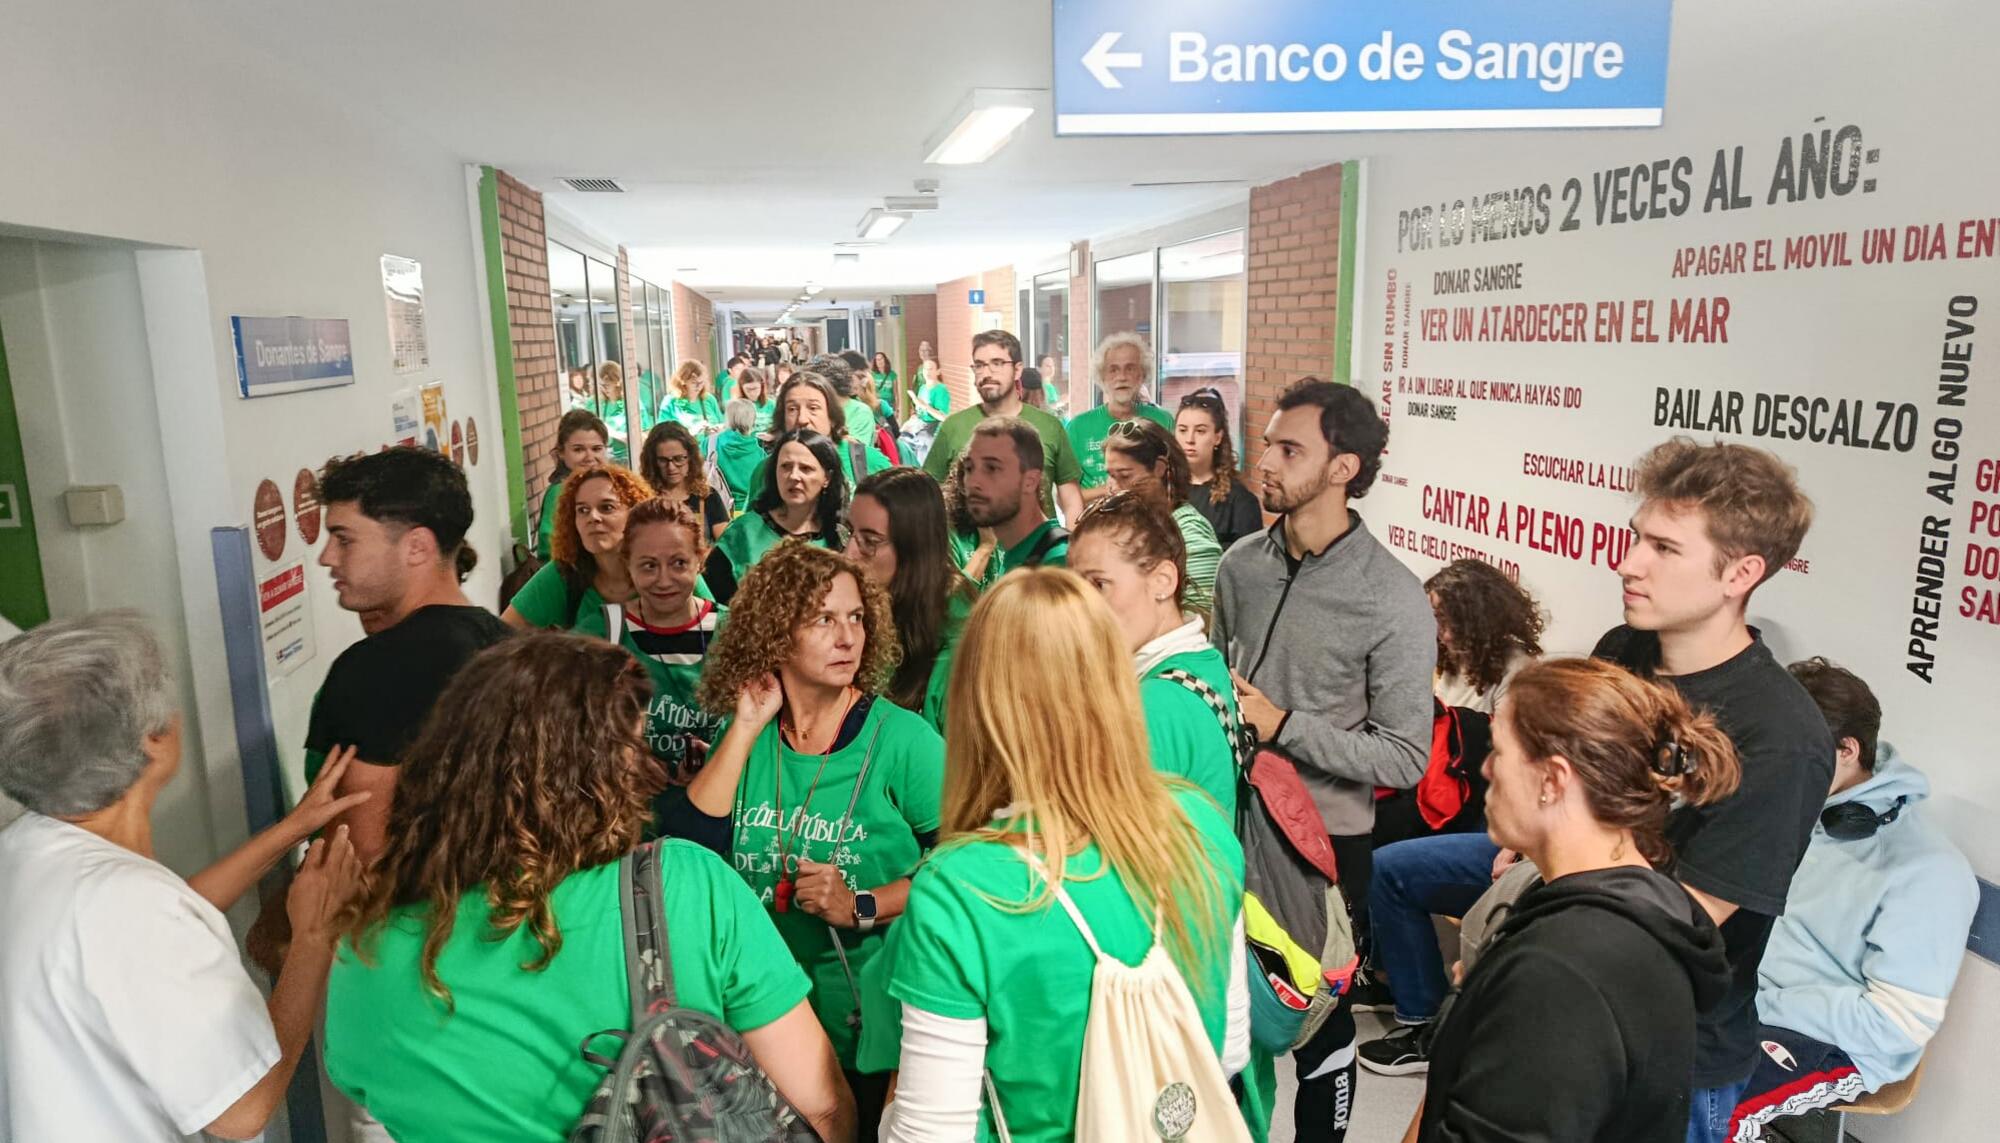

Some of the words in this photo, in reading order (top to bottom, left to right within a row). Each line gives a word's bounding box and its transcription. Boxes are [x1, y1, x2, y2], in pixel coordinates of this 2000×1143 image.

[1169, 32, 1347, 82] Banco
[1358, 31, 1424, 80] de
[1435, 29, 1624, 92] Sangre
[1398, 206, 1432, 253] POR
[1440, 200, 1464, 247] LO
[1470, 184, 1552, 244] MENOS
[1560, 178, 1582, 231] 2
[1593, 156, 1692, 226] VECES
[1703, 145, 1752, 213] AL
[1767, 116, 1880, 205] AÑO:
[1672, 242, 1747, 278] APAGAR
[1753, 239, 1776, 271] EL
[1784, 232, 1852, 270] MOVIL
[1862, 228, 1896, 264] UN
[1903, 223, 1947, 262] DIA
[1956, 217, 2000, 258] EN
[1385, 268, 1397, 335] RUMBO
[1434, 268, 1470, 295] DONAR
[1474, 263, 1523, 292] SANGRE
[1421, 308, 1447, 341] VER
[1453, 307, 1473, 341] UN
[1478, 303, 1587, 342] ATARDECER
[1595, 301, 1624, 342] EN
[1631, 299, 1659, 342] EL
[1668, 297, 1730, 343] MAR
[255, 340, 304, 367] Donantes
[306, 339, 317, 364] de
[318, 338, 348, 368] Sangre
[1384, 342, 1393, 372] SIN
[1937, 295, 1978, 406] NUEVO
[1398, 376, 1406, 393] IR
[1408, 377, 1413, 394] A
[1415, 377, 1426, 394] UN
[1427, 378, 1454, 397] LUGAR
[1456, 380, 1467, 398] AL
[1470, 381, 1488, 400] QUE
[1490, 382, 1521, 403] NUNCA
[1524, 384, 1561, 407] HAYAS
[1563, 387, 1582, 409] IDO
[1407, 402, 1429, 417] DONAR
[1430, 404, 1457, 421] SANGRE
[1654, 387, 1744, 434] BAILAR
[1752, 393, 1918, 452] DESCALZO
[1523, 453, 1584, 484] ESCUCHAR
[1588, 462, 1605, 488] LA
[1926, 418, 1963, 505] ALGO
[1388, 524, 1405, 548] VER
[1408, 531, 1418, 552] EL
[1421, 534, 1447, 561] CIELO
[1422, 484, 1489, 536] CANTAR
[1496, 502, 1509, 541] A
[1516, 505, 1584, 560] PLENO
[1906, 514, 1951, 683] APRENDER
[735, 852, 762, 872] DE
